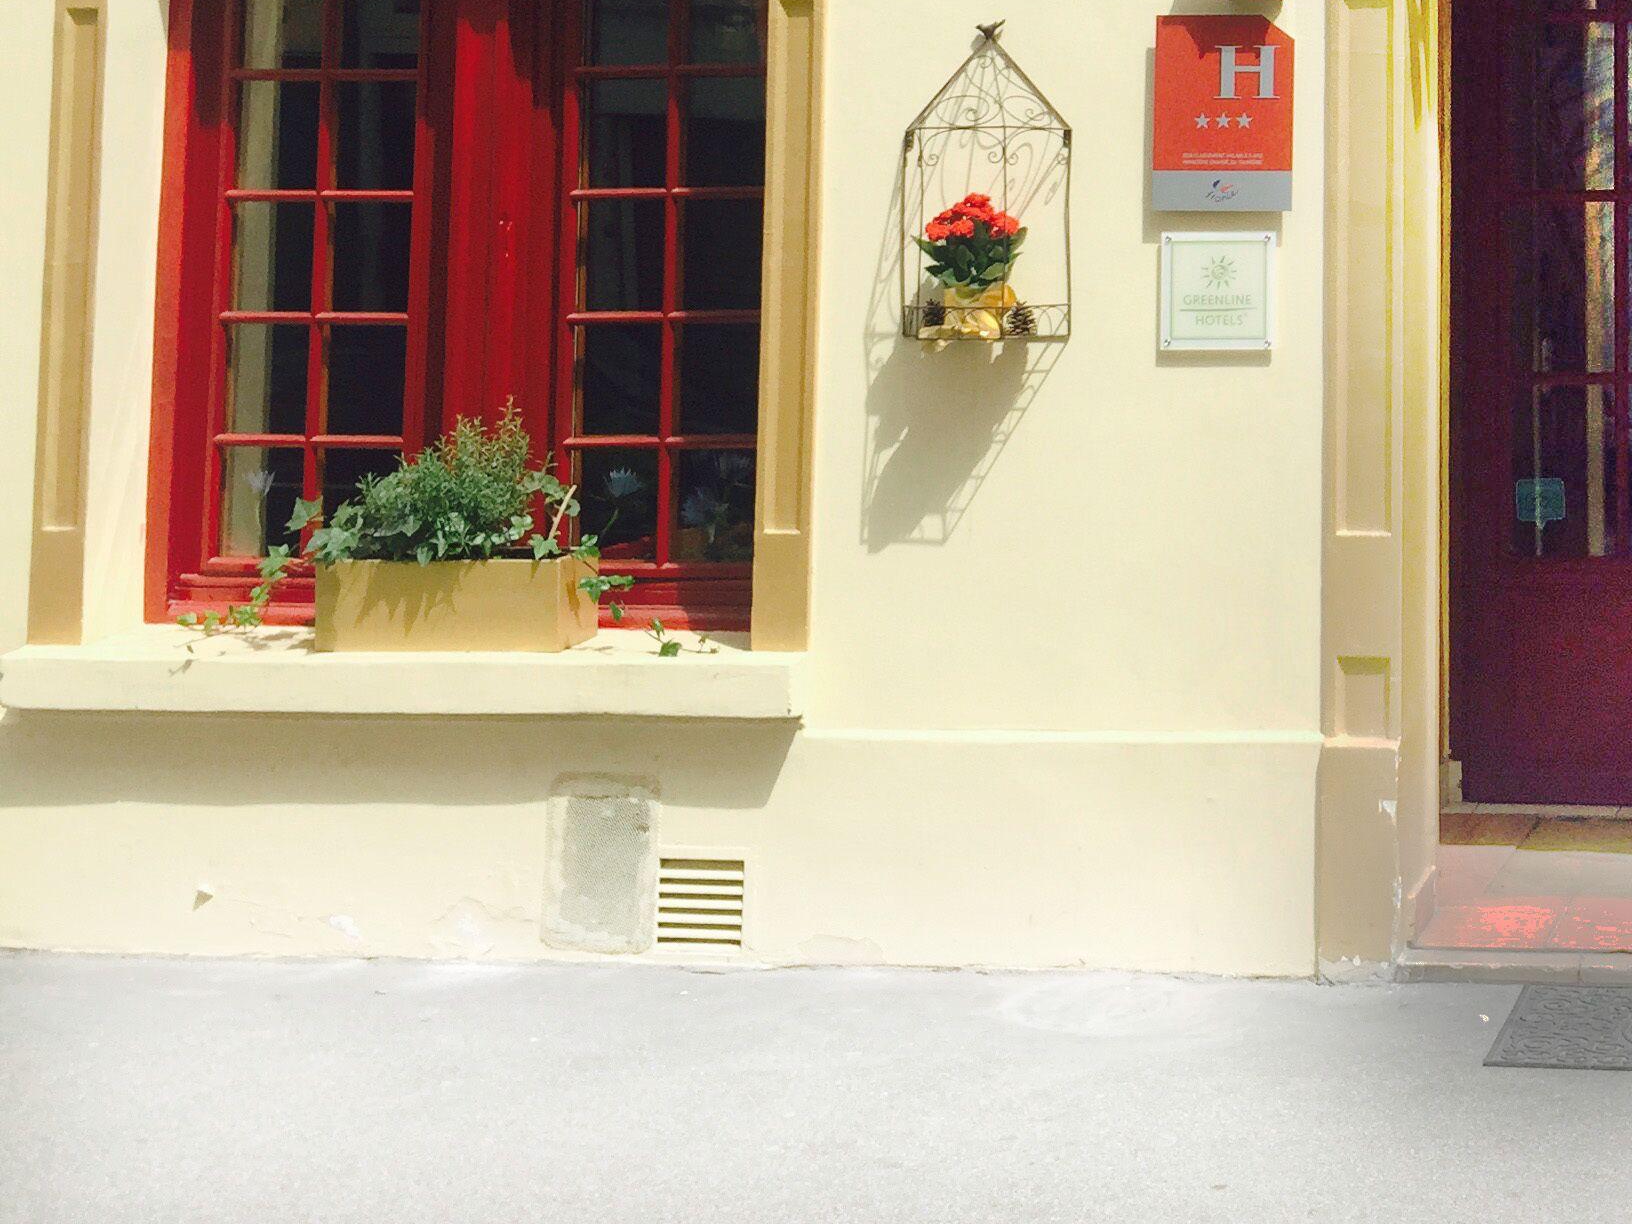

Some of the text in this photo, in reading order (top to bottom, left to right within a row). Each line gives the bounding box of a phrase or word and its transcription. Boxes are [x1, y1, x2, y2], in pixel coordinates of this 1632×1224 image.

[1213, 44, 1281, 99] H
[1183, 294, 1252, 305] GREENLINE
[1195, 314, 1244, 326] HOTELS
